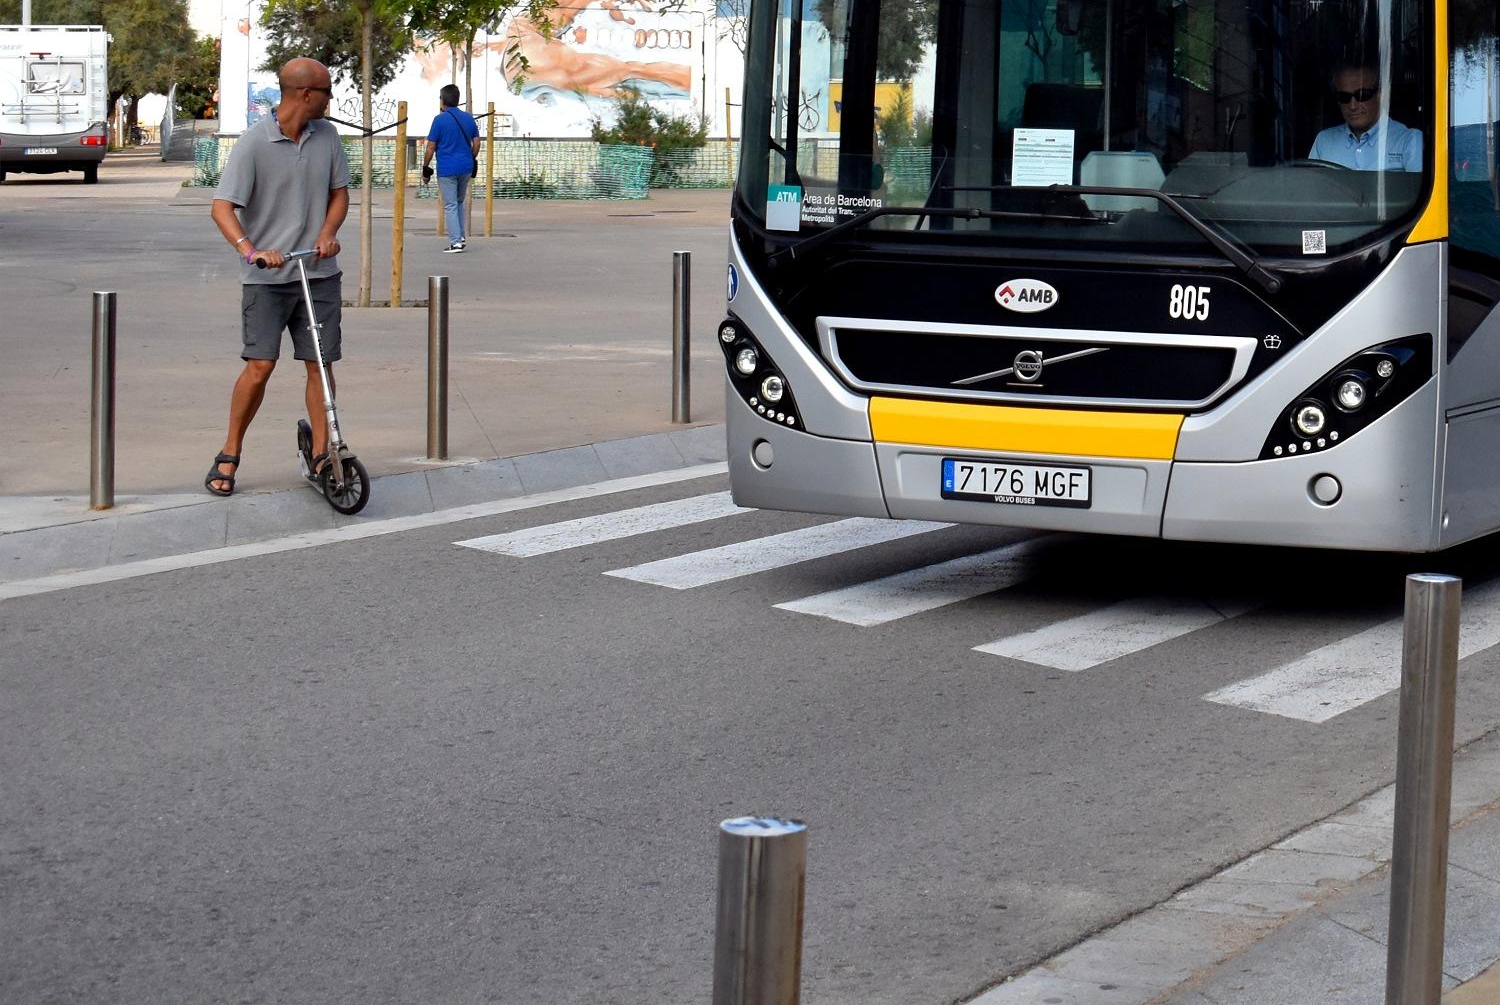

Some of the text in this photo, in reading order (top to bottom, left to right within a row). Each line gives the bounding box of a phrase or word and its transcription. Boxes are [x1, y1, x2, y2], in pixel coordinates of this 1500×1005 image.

[776, 191, 798, 203] ATM
[824, 194, 836, 205] de
[837, 194, 882, 208] Barcelona
[801, 206, 827, 214] Autoritat
[828, 206, 838, 215] del
[1017, 288, 1053, 304] AMB
[1169, 284, 1211, 321] 805
[1016, 362, 1041, 371] VOLVO
[946, 479, 952, 488] E
[960, 465, 1083, 498] 7176 MGF
[994, 495, 1036, 505] VOLVO BUSES
